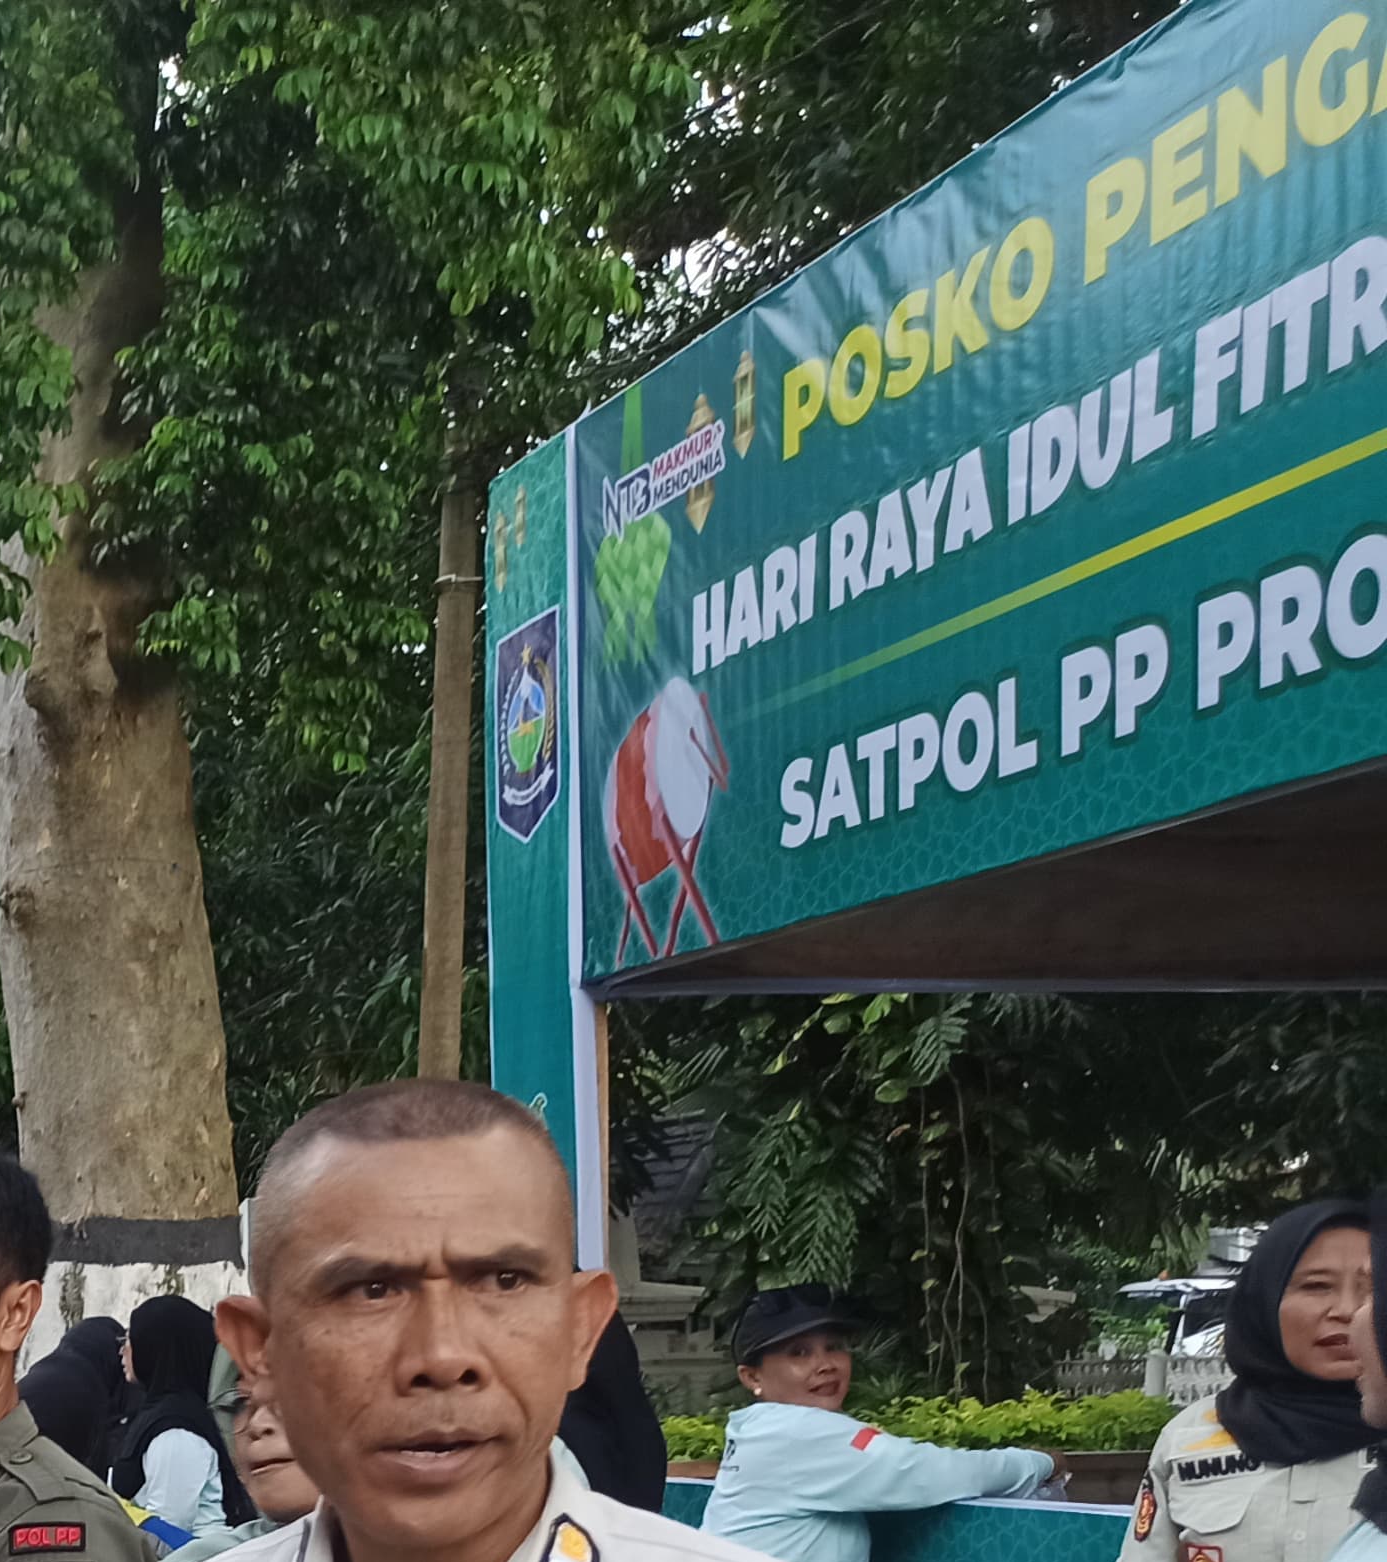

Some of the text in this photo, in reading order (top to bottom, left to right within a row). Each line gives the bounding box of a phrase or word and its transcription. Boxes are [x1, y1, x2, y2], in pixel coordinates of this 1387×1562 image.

[783, 12, 1387, 462] POSKO PENG
[652, 428, 713, 480] MAKMUR
[652, 448, 723, 505] MENDUNIA
[604, 467, 651, 539] NTB
[693, 532, 818, 676] HARI
[829, 446, 993, 611] RAYA
[1008, 346, 1174, 526] IDUL
[780, 677, 1037, 848] SATPOL
[1060, 624, 1169, 757] PP
[15, 1527, 82, 1547] POL PP
